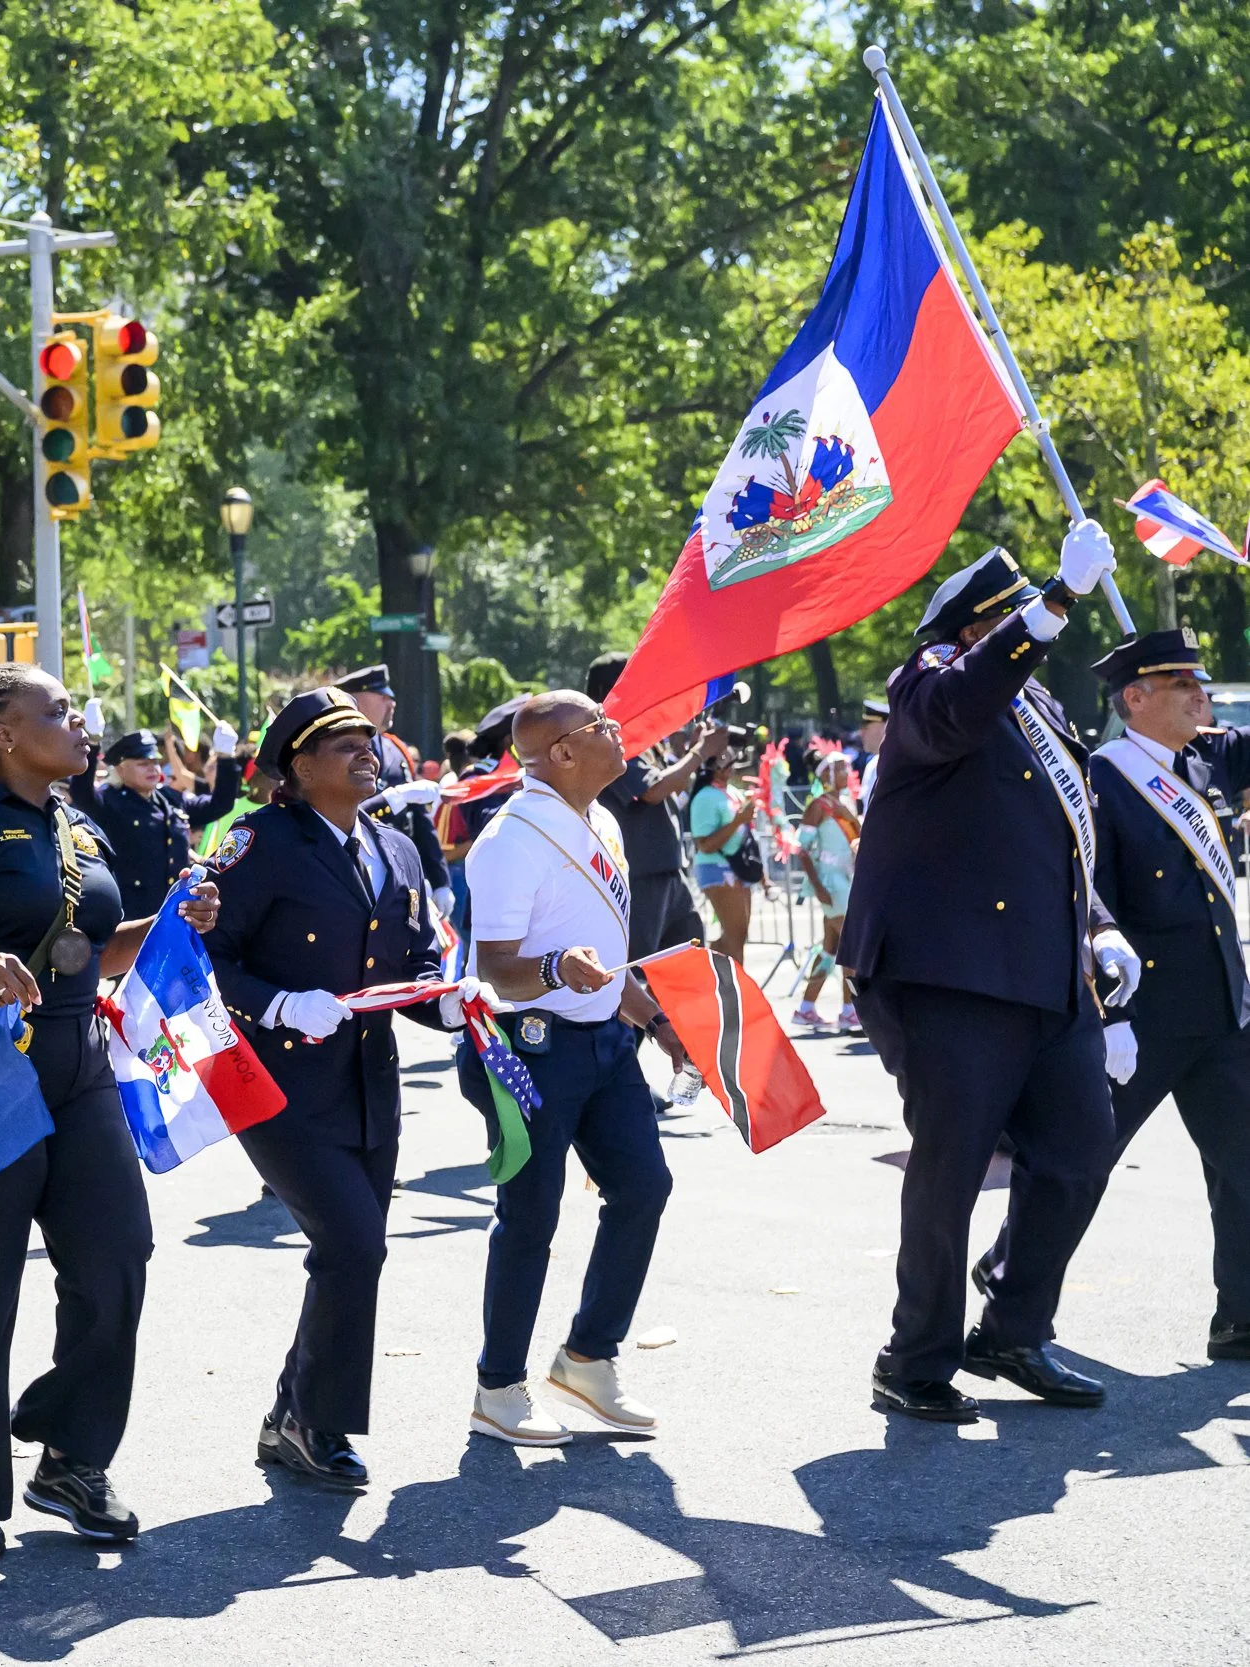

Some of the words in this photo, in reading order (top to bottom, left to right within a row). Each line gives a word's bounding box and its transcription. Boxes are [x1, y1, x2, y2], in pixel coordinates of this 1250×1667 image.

[1018, 706, 1059, 768] HONORARY
[1054, 768, 1084, 809] GRAND
[1077, 808, 1093, 868] MARSHAL
[1171, 796, 1211, 848] HONORARY
[1207, 844, 1229, 879] GRAND
